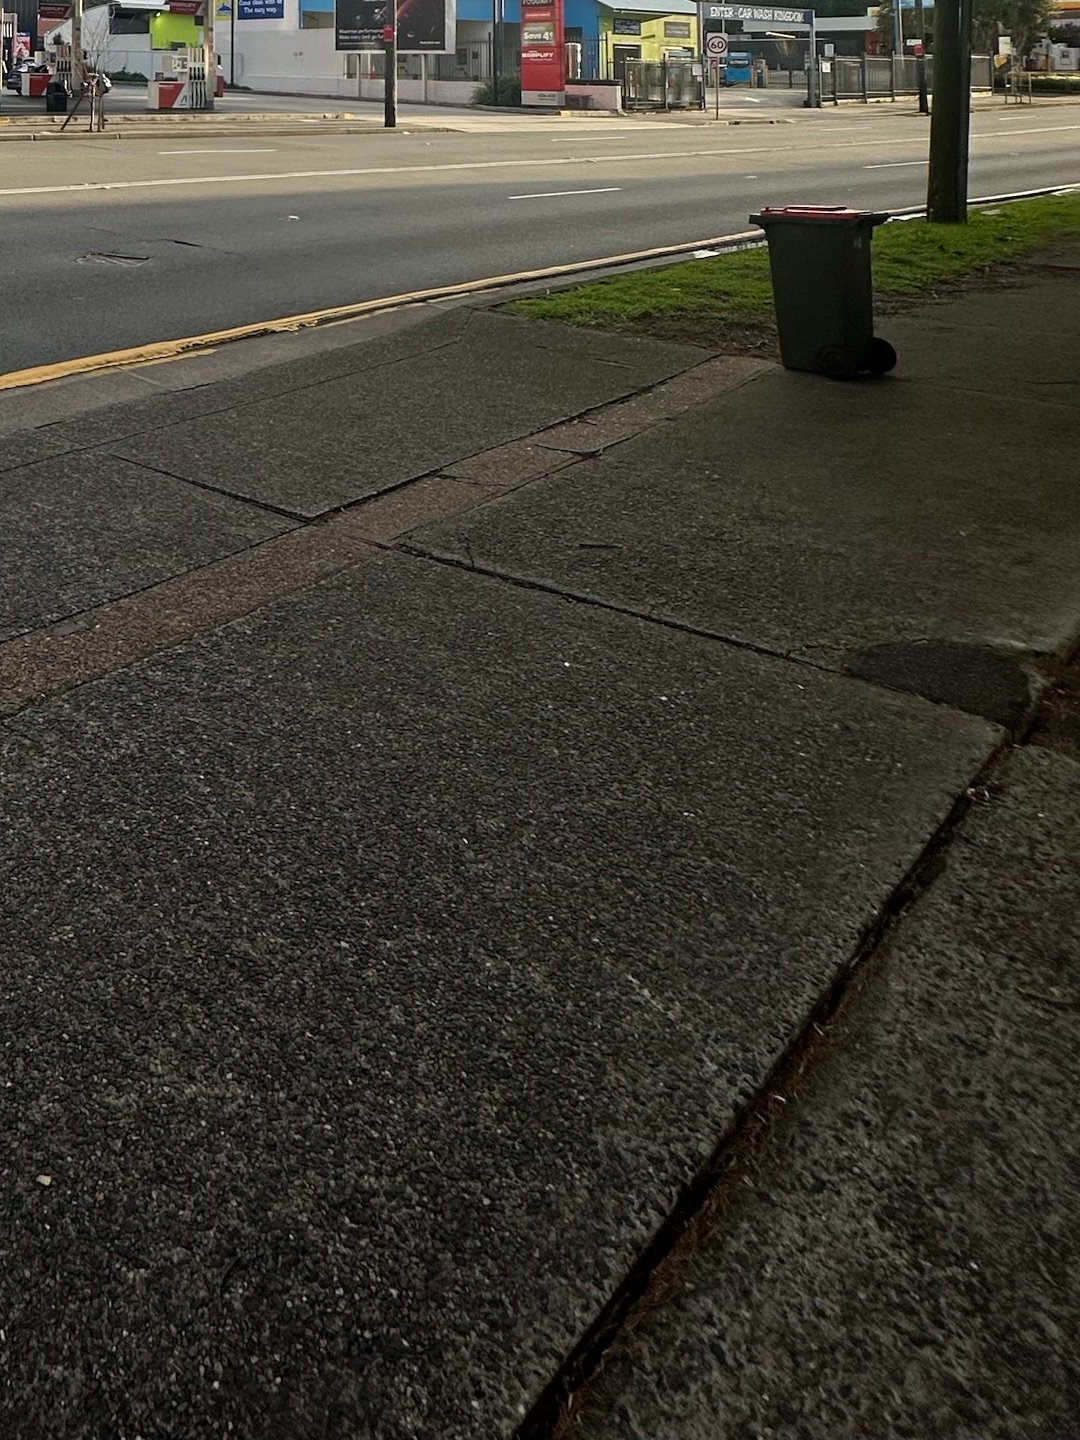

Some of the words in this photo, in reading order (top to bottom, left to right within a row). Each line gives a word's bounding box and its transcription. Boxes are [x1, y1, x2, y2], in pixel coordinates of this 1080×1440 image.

[710, 6, 734, 17] ENTER
[738, 8, 753, 18] CAR
[753, 9, 772, 20] WASH
[524, 32, 542, 40] Save
[711, 41, 724, 49] 60
